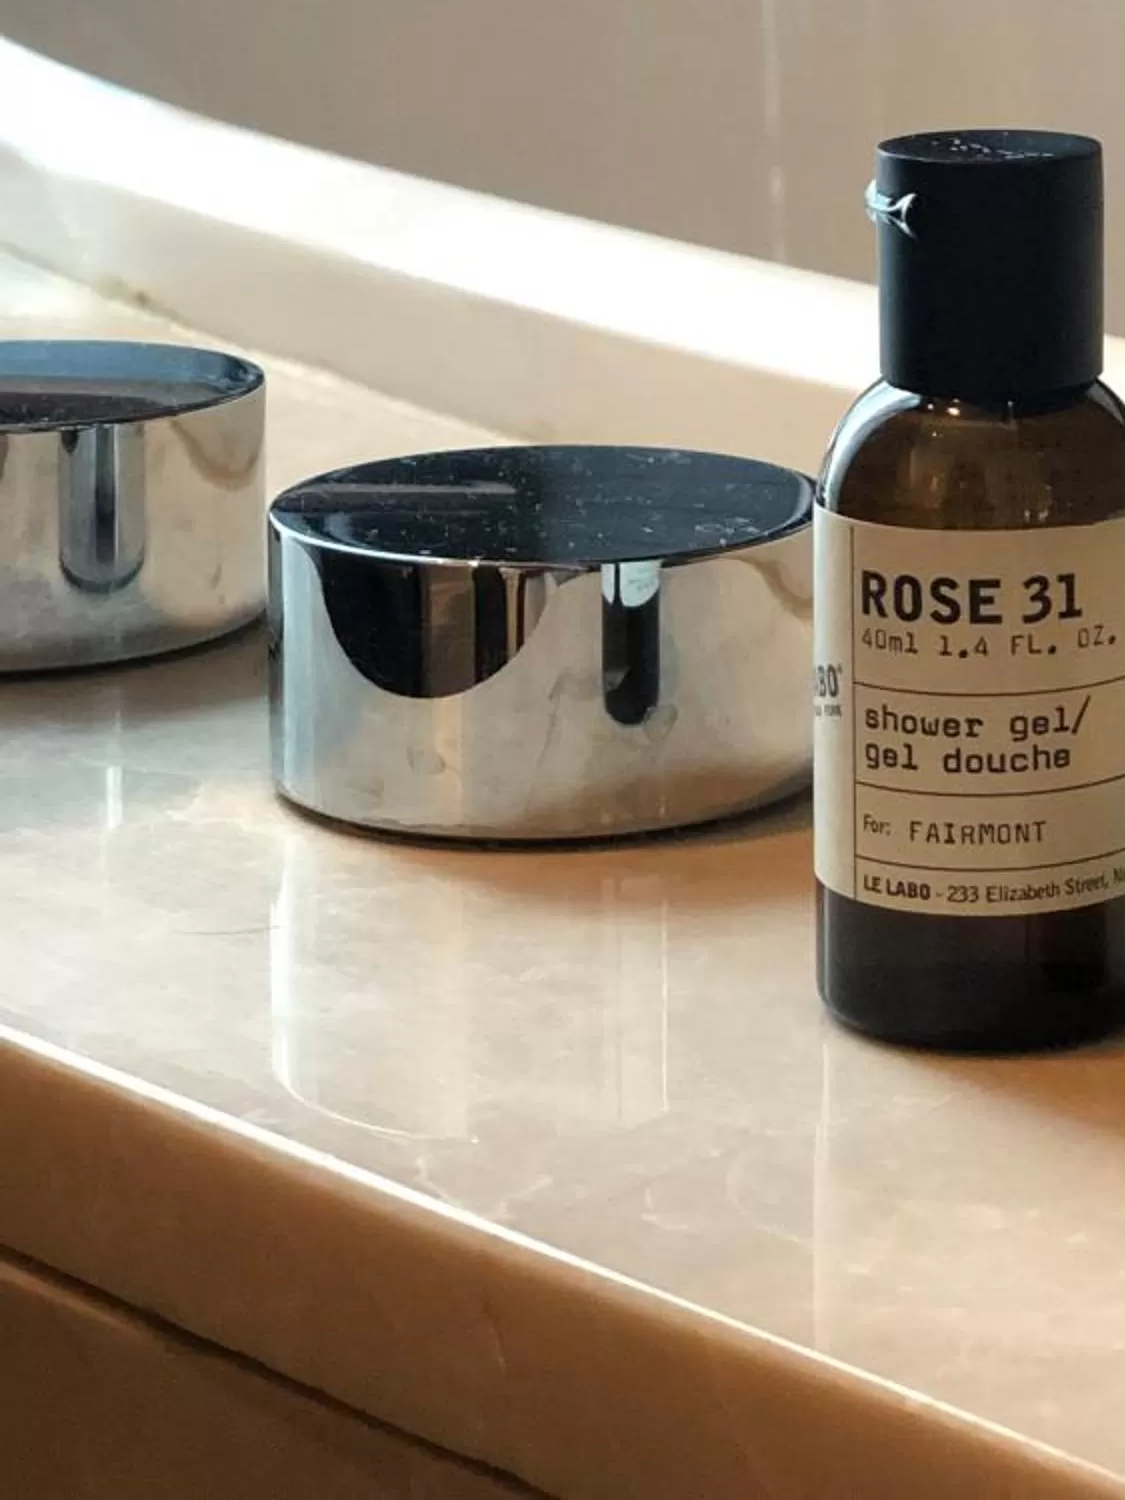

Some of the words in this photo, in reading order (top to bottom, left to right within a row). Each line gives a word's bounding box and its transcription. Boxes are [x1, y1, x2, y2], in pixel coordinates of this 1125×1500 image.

[861, 569, 1003, 626] ROSE
[1021, 572, 1083, 624] 31
[861, 628, 918, 656] 40ml
[938, 634, 989, 659] 1.4
[1010, 634, 1057, 657] FL.
[1077, 624, 1117, 649] OZ.
[815, 664, 838, 698] BO
[865, 704, 984, 739] shower
[1009, 695, 1091, 743] gel/
[865, 741, 919, 771] gel
[943, 743, 1071, 774] douche
[863, 812, 891, 838] For:
[909, 819, 1047, 845] FAIRMONT
[863, 873, 881, 894] LE
[885, 878, 931, 901] LABO
[947, 884, 979, 903] 233
[985, 880, 1060, 903] Elizabeth
[1064, 875, 1109, 896] Street,
